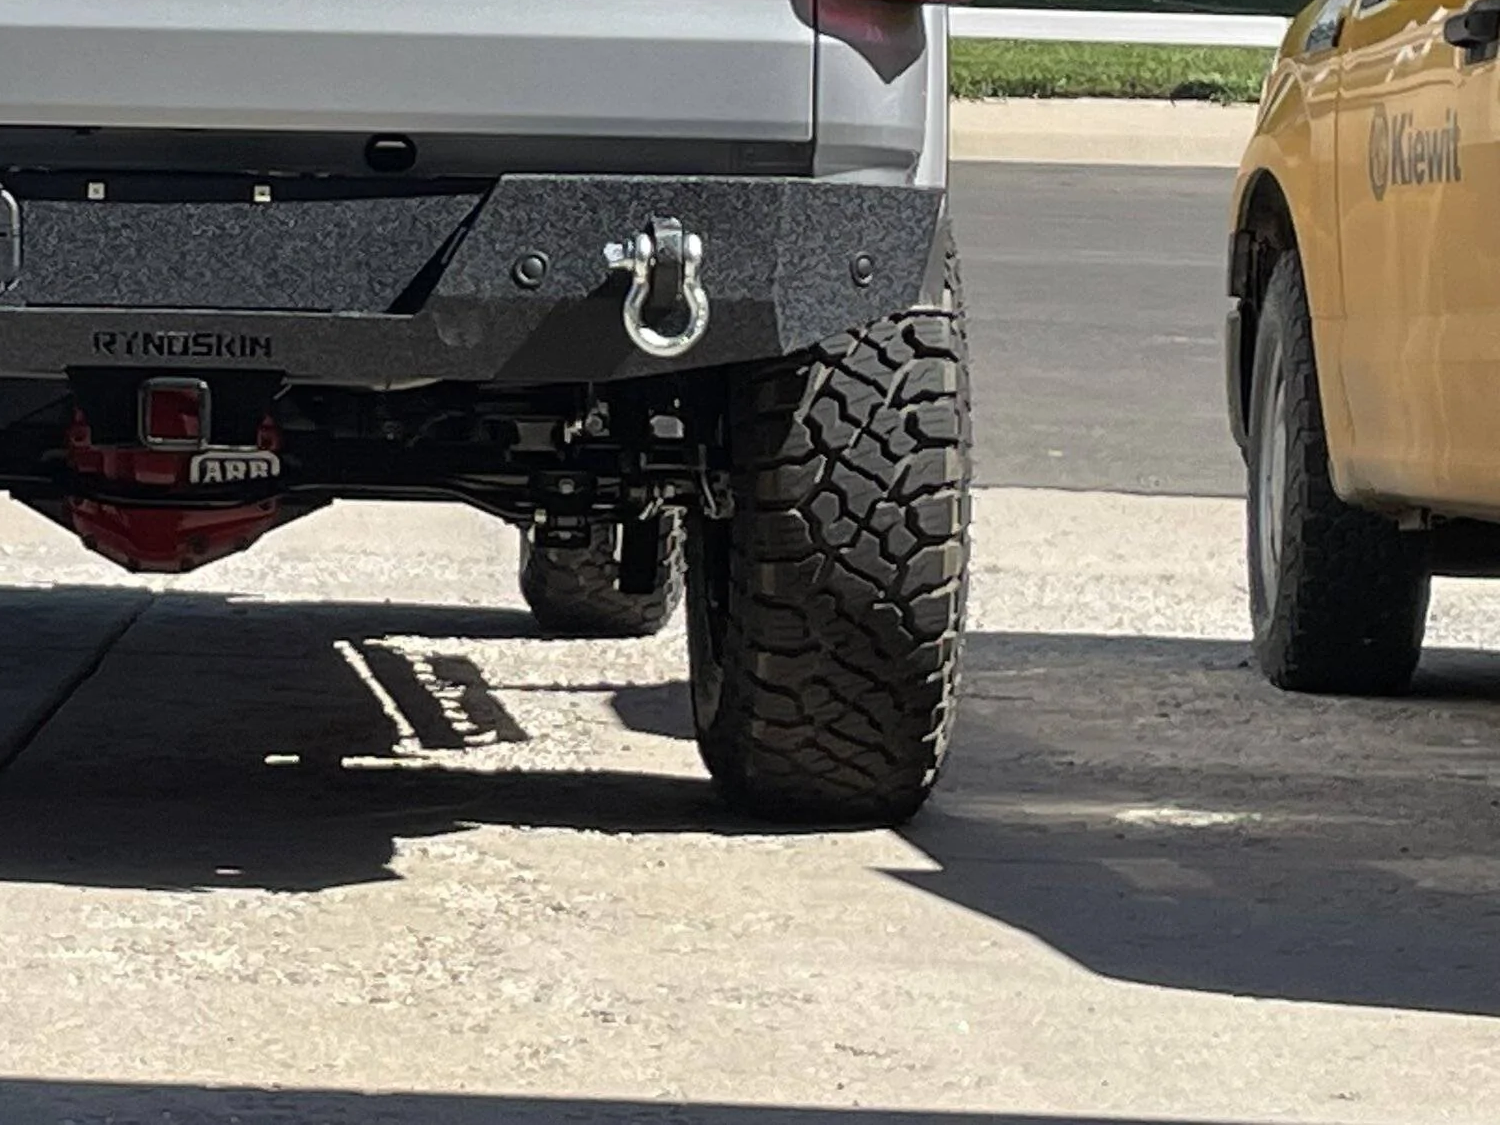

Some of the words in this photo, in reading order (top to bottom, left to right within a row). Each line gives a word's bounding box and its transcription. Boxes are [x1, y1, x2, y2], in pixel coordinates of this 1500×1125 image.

[1391, 108, 1462, 186] Kiewit
[92, 330, 273, 358] RYNOSKIN
[202, 460, 270, 484] ARB
